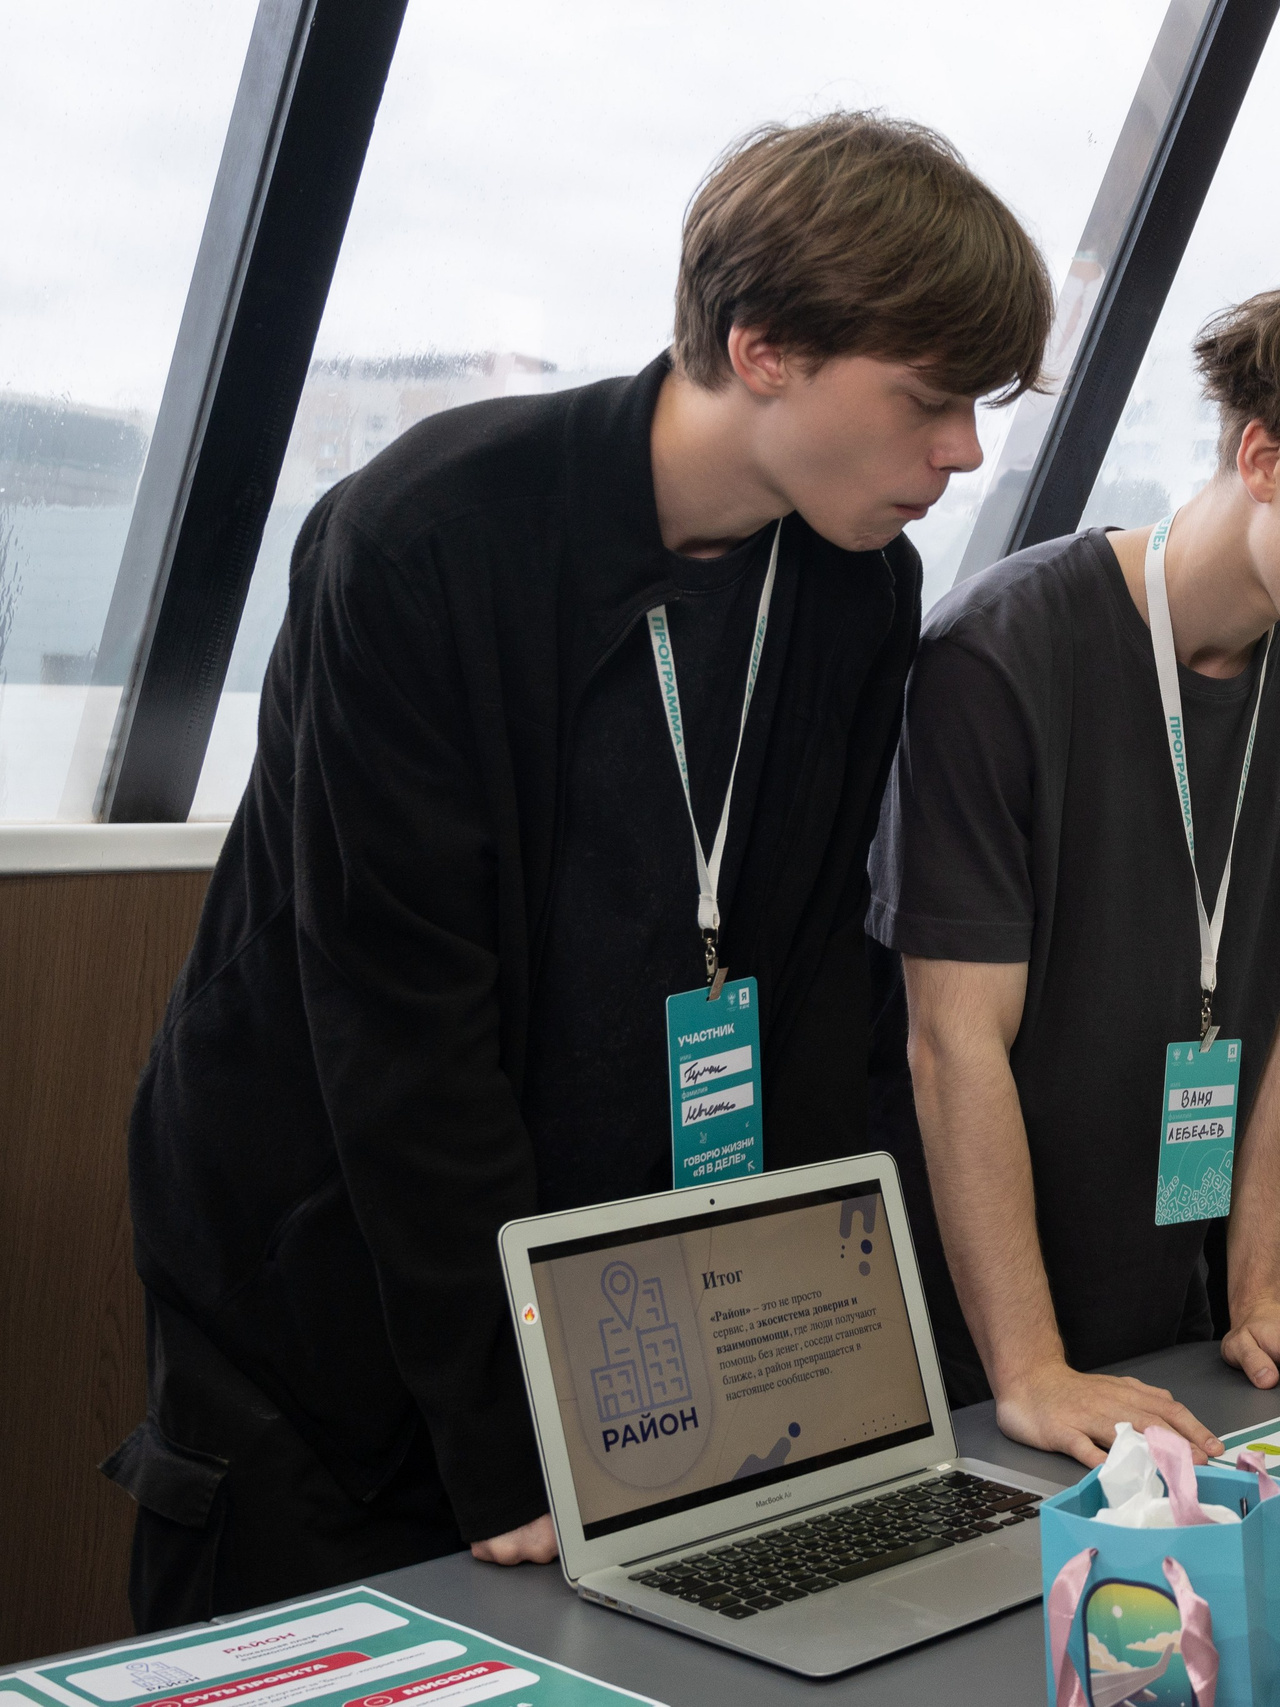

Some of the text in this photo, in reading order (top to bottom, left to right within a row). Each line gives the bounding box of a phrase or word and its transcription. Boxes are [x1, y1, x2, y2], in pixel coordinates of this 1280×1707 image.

[652, 615, 682, 746] ПРОГРАММА
[1169, 716, 1192, 827] ПРОГРАММА
[677, 1022, 735, 1048] УЧАСТНИК
[681, 1085, 708, 1101] фамилия
[1181, 1089, 1213, 1108] ВАНЯ
[1168, 1122, 1225, 1142] ЛЕБЕДЕВ
[683, 1136, 755, 1168] ГОВОРЮ ЖИЗНИ
[693, 1153, 746, 1178] «Я В ДЕЛЕ»
[702, 1270, 743, 1290] Итог
[710, 1307, 750, 1322] «Район»
[762, 1301, 776, 1311] это
[779, 1298, 789, 1307] не
[791, 1290, 822, 1305] просто
[713, 1296, 858, 1339] сервис, а экосистема доверия и
[716, 1307, 877, 1355] взаимопомощи, где люди получают
[720, 1321, 882, 1370] помощь без денег, соседи становятся
[722, 1370, 756, 1385] ближе,
[765, 1359, 791, 1376] район
[794, 1344, 854, 1367] превращается
[857, 1342, 861, 1350] в
[726, 1367, 832, 1401] настоящее сообщество.
[602, 1405, 700, 1453] РАЙОН
[755, 1493, 784, 1508] MacBook
[222, 1632, 296, 1654] РАЙОН
[146, 1676, 201, 1692] РАЙОН
[182, 1663, 329, 1705] СУТЬ ПРОЕКТА
[402, 1666, 489, 1696] МИССИЯ
